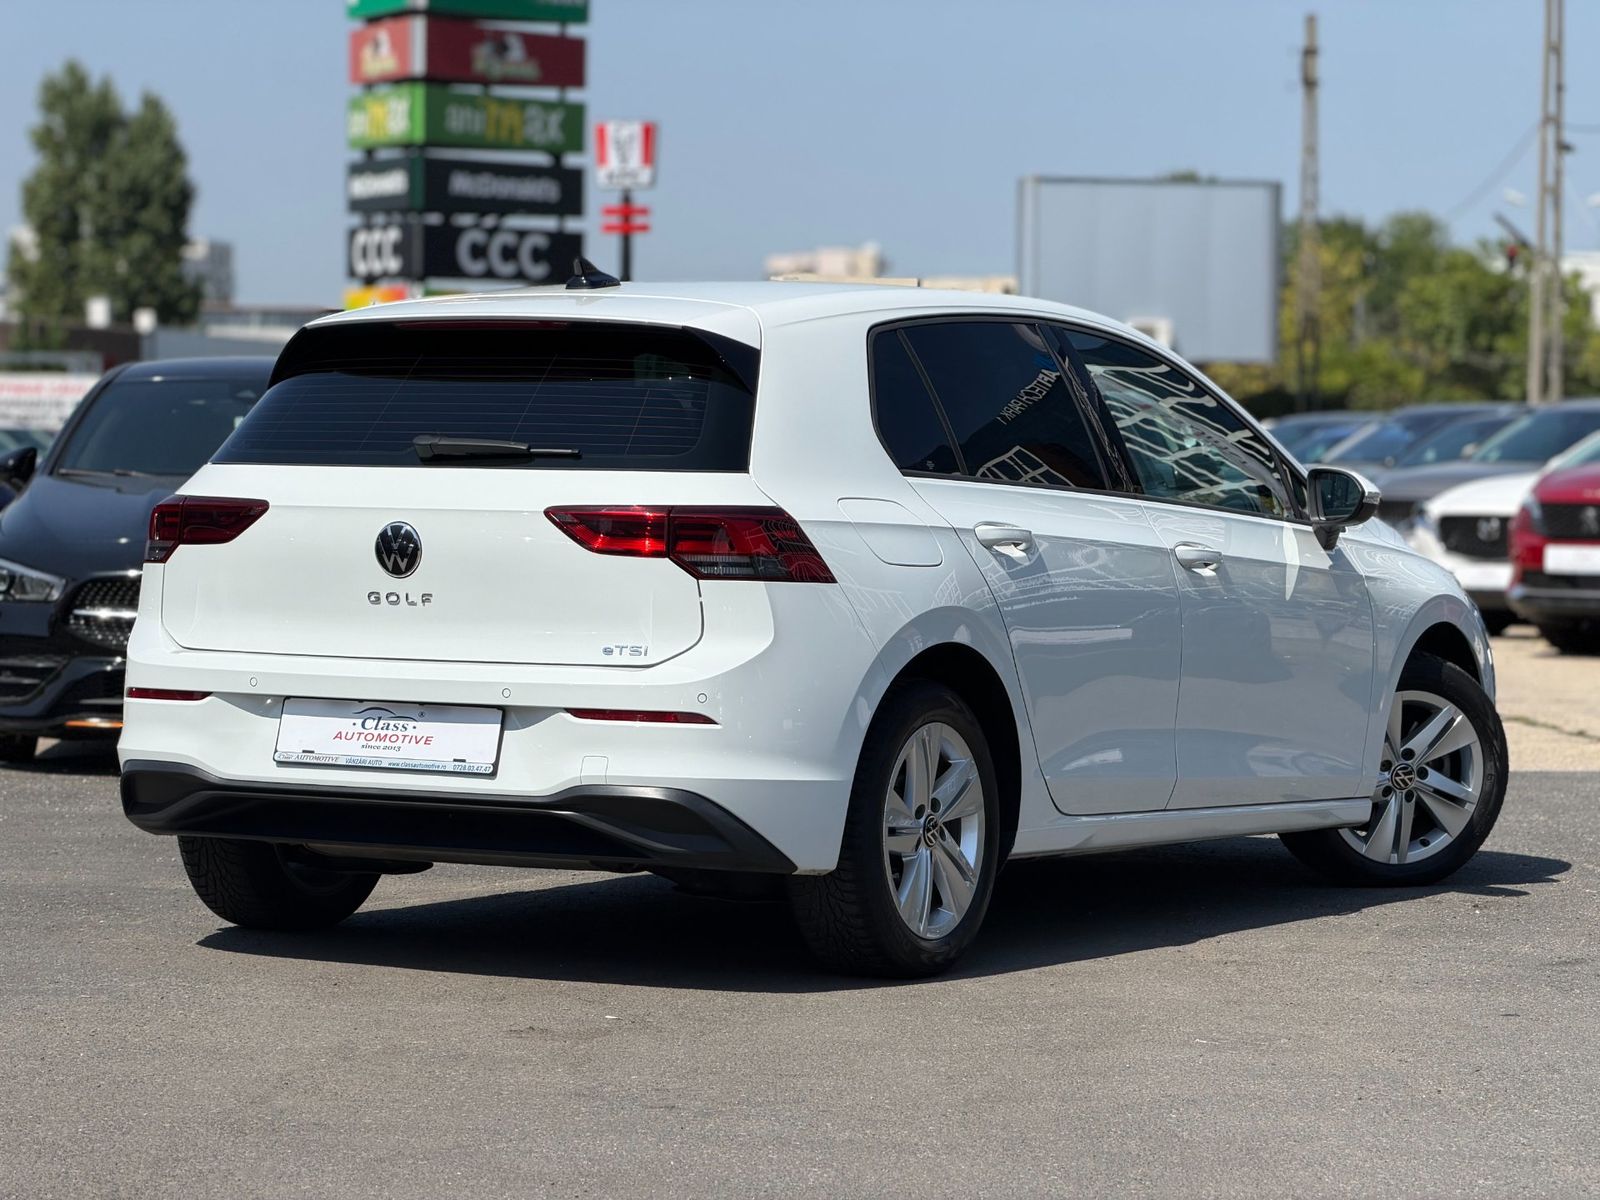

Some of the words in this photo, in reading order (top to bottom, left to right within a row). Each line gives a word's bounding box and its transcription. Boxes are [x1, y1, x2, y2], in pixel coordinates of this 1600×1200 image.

[350, 226, 402, 277] CCC
[456, 229, 551, 280] CCC
[367, 591, 433, 607] GOLF
[602, 644, 649, 657] eTSI
[361, 716, 409, 732] Class
[333, 731, 434, 745] AUTOMOTIVE
[295, 754, 339, 763] AUTOMOTIVE
